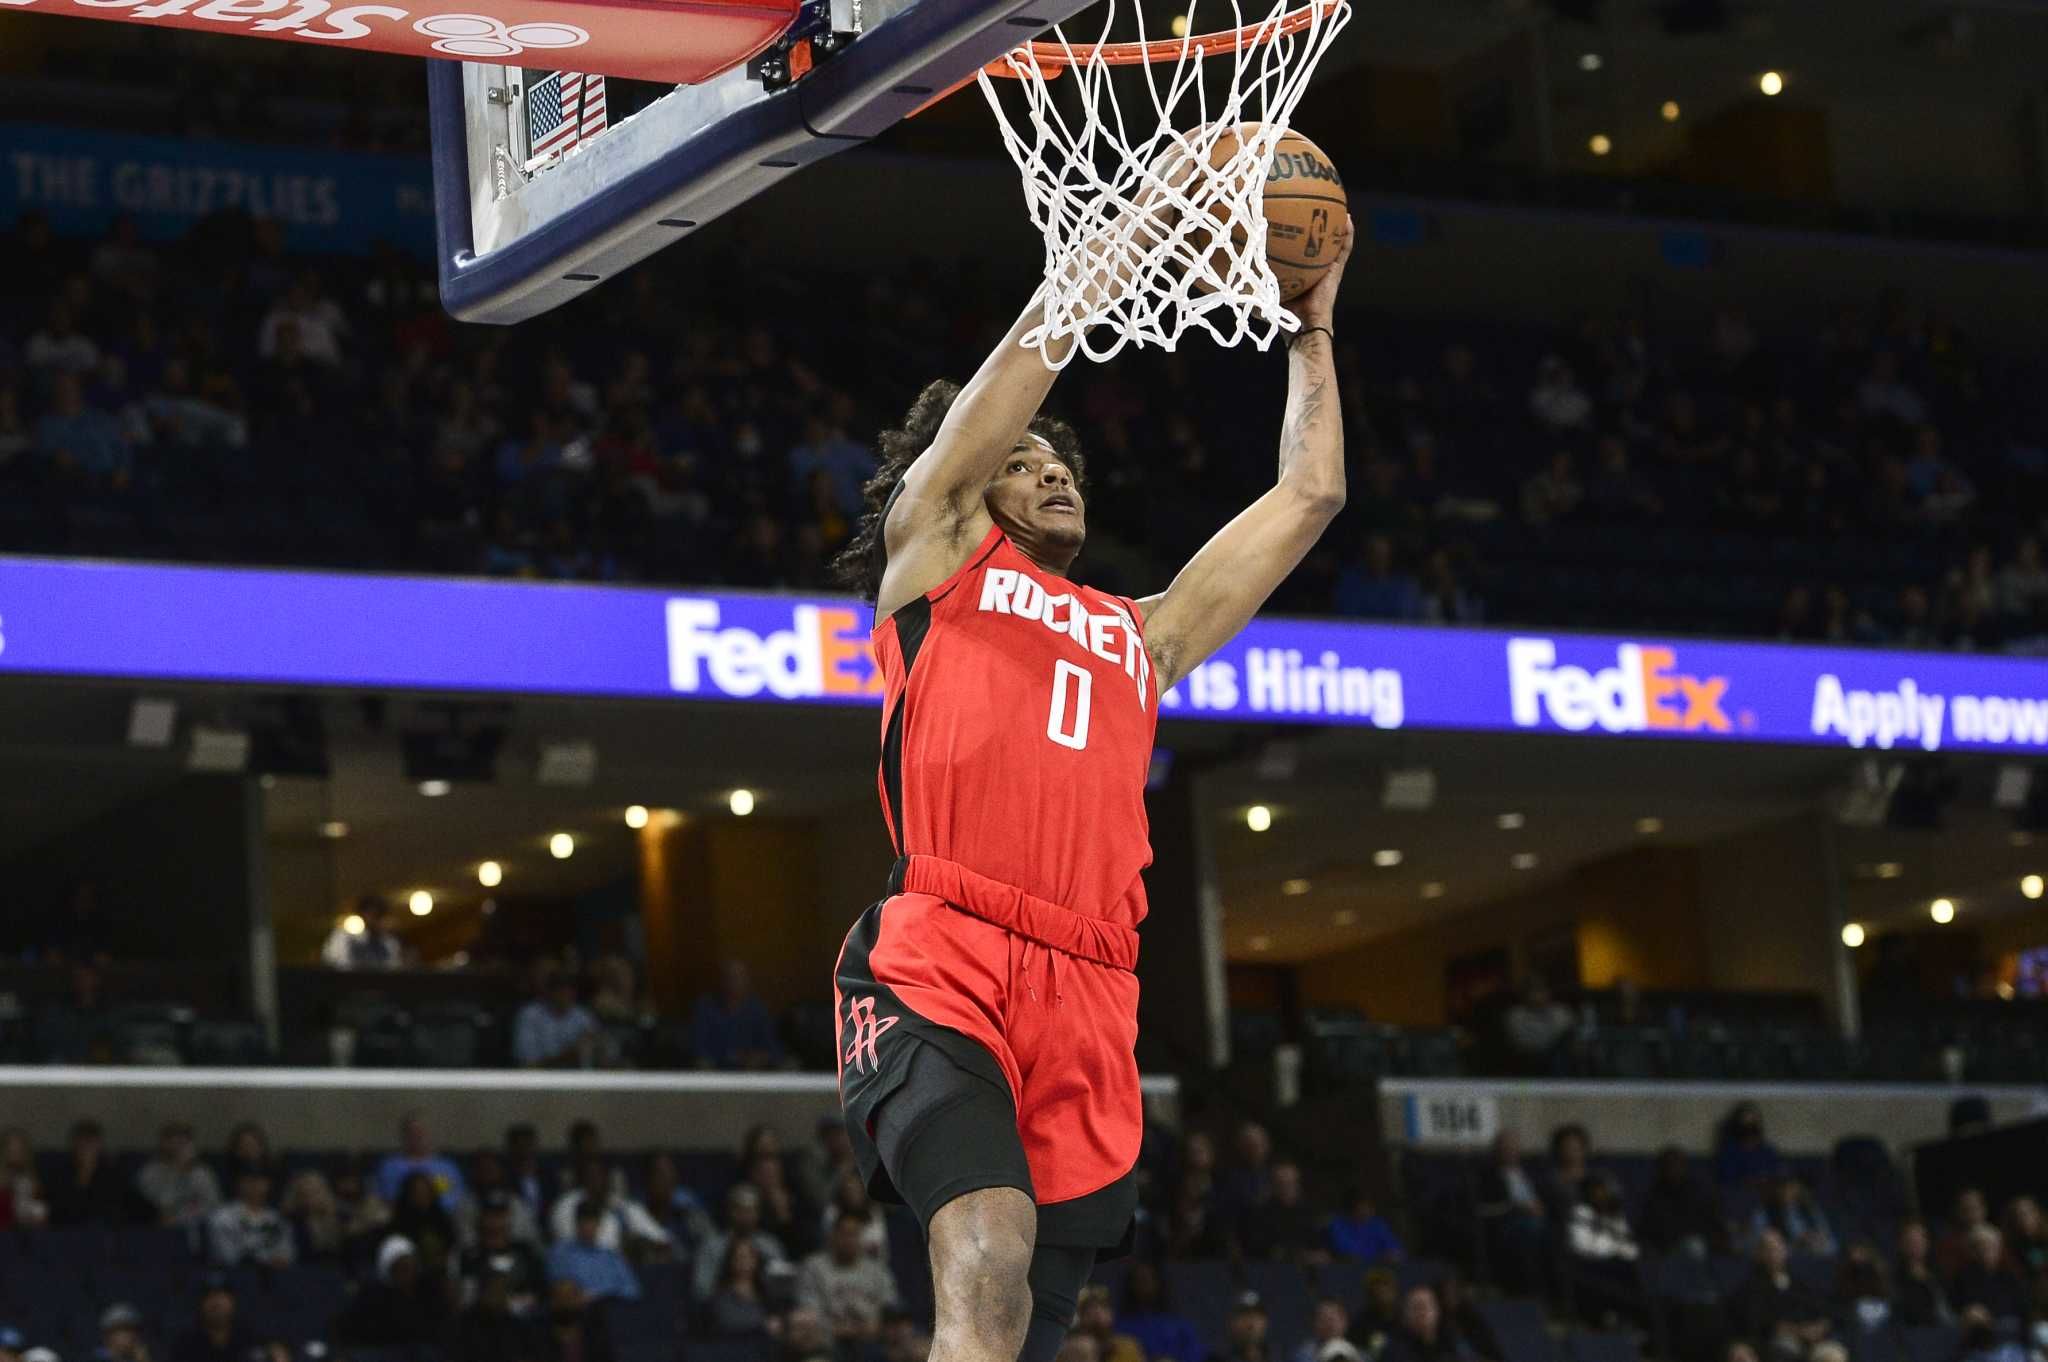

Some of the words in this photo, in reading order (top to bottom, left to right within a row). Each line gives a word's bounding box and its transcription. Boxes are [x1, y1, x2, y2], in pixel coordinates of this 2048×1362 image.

[13, 151, 96, 207] THE
[978, 567, 1150, 713] ROCKETS
[1047, 658, 1094, 751] 0
[1246, 648, 1405, 729] Hiring
[1507, 638, 1733, 732] FedEx
[1811, 674, 1946, 751] Apply
[1951, 694, 2048, 745] now
